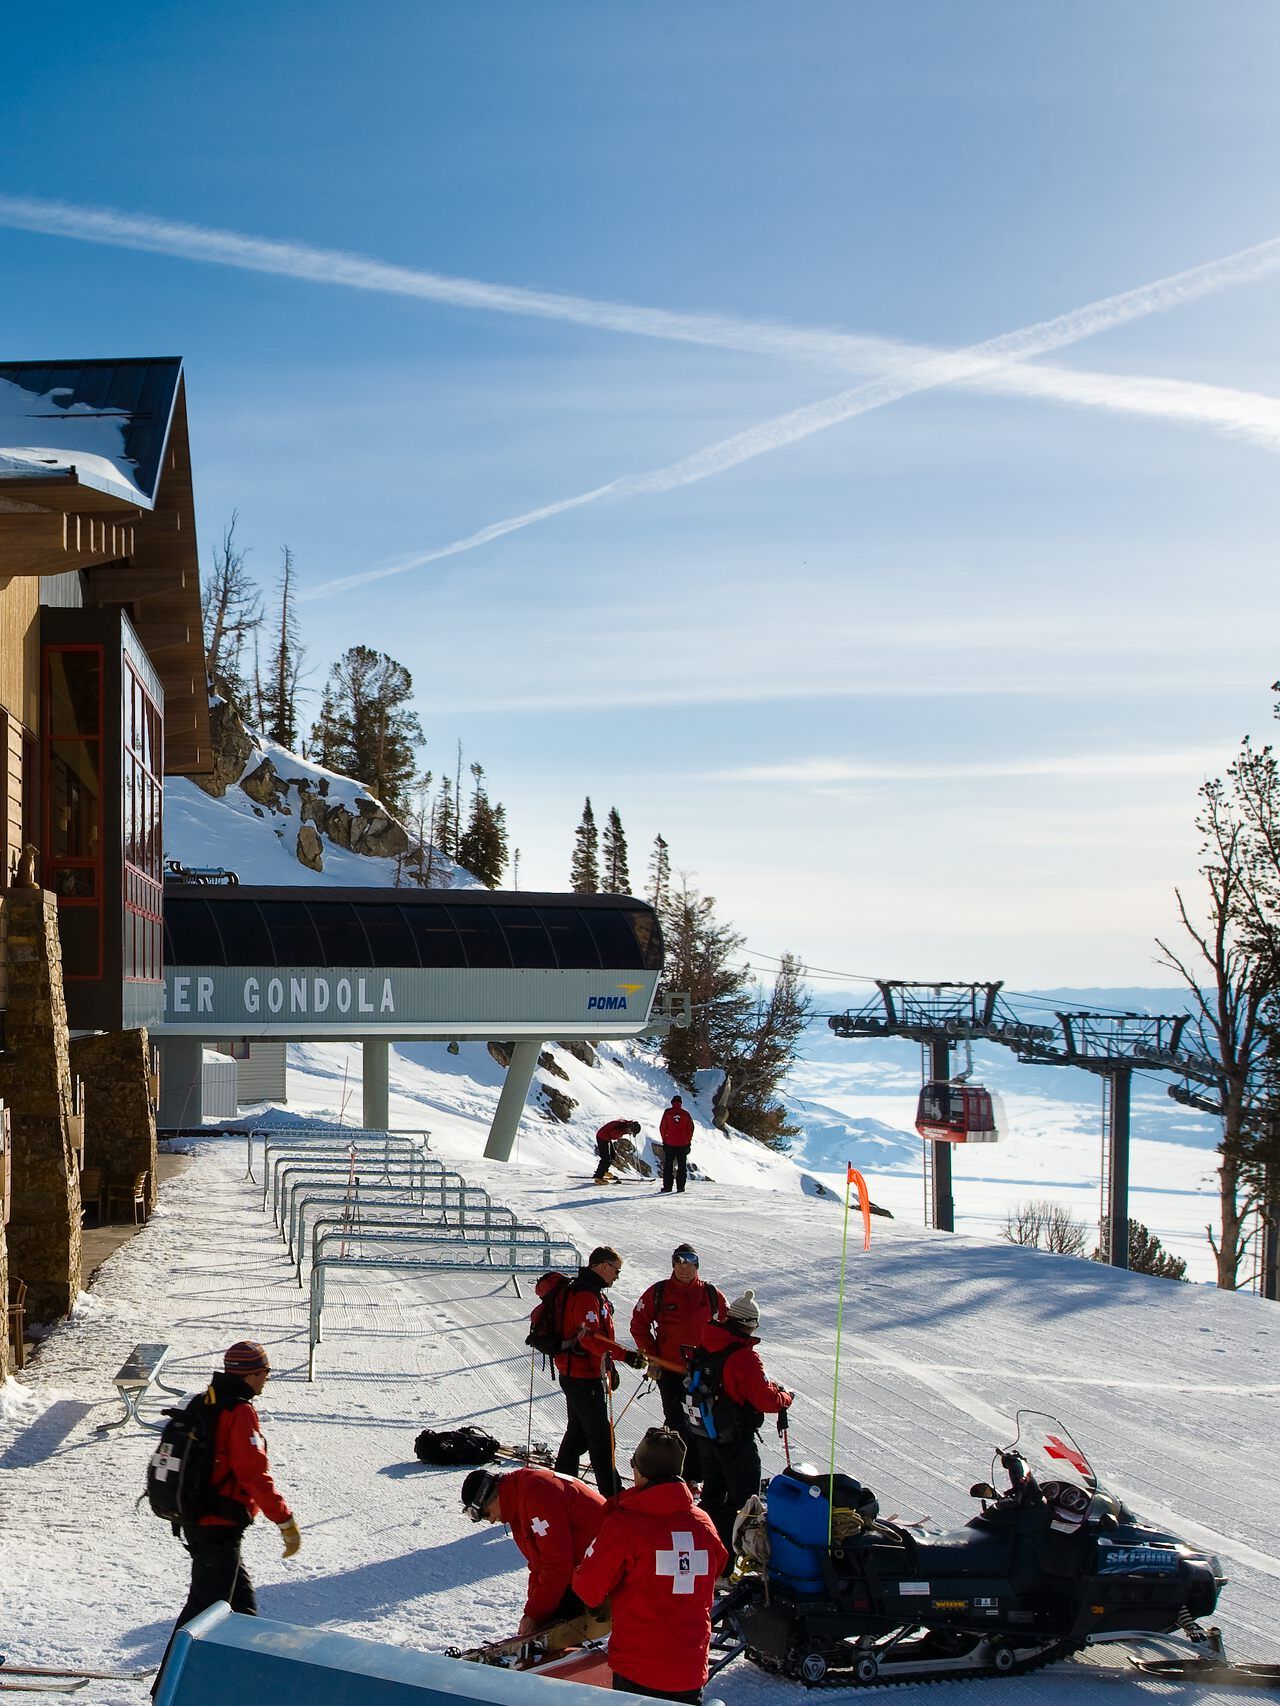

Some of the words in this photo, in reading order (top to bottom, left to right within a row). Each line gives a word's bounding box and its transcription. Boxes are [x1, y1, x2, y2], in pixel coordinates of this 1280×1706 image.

[163, 976, 215, 1013] ER
[243, 976, 395, 1014] GONDOLA
[587, 996, 628, 1010] POMA
